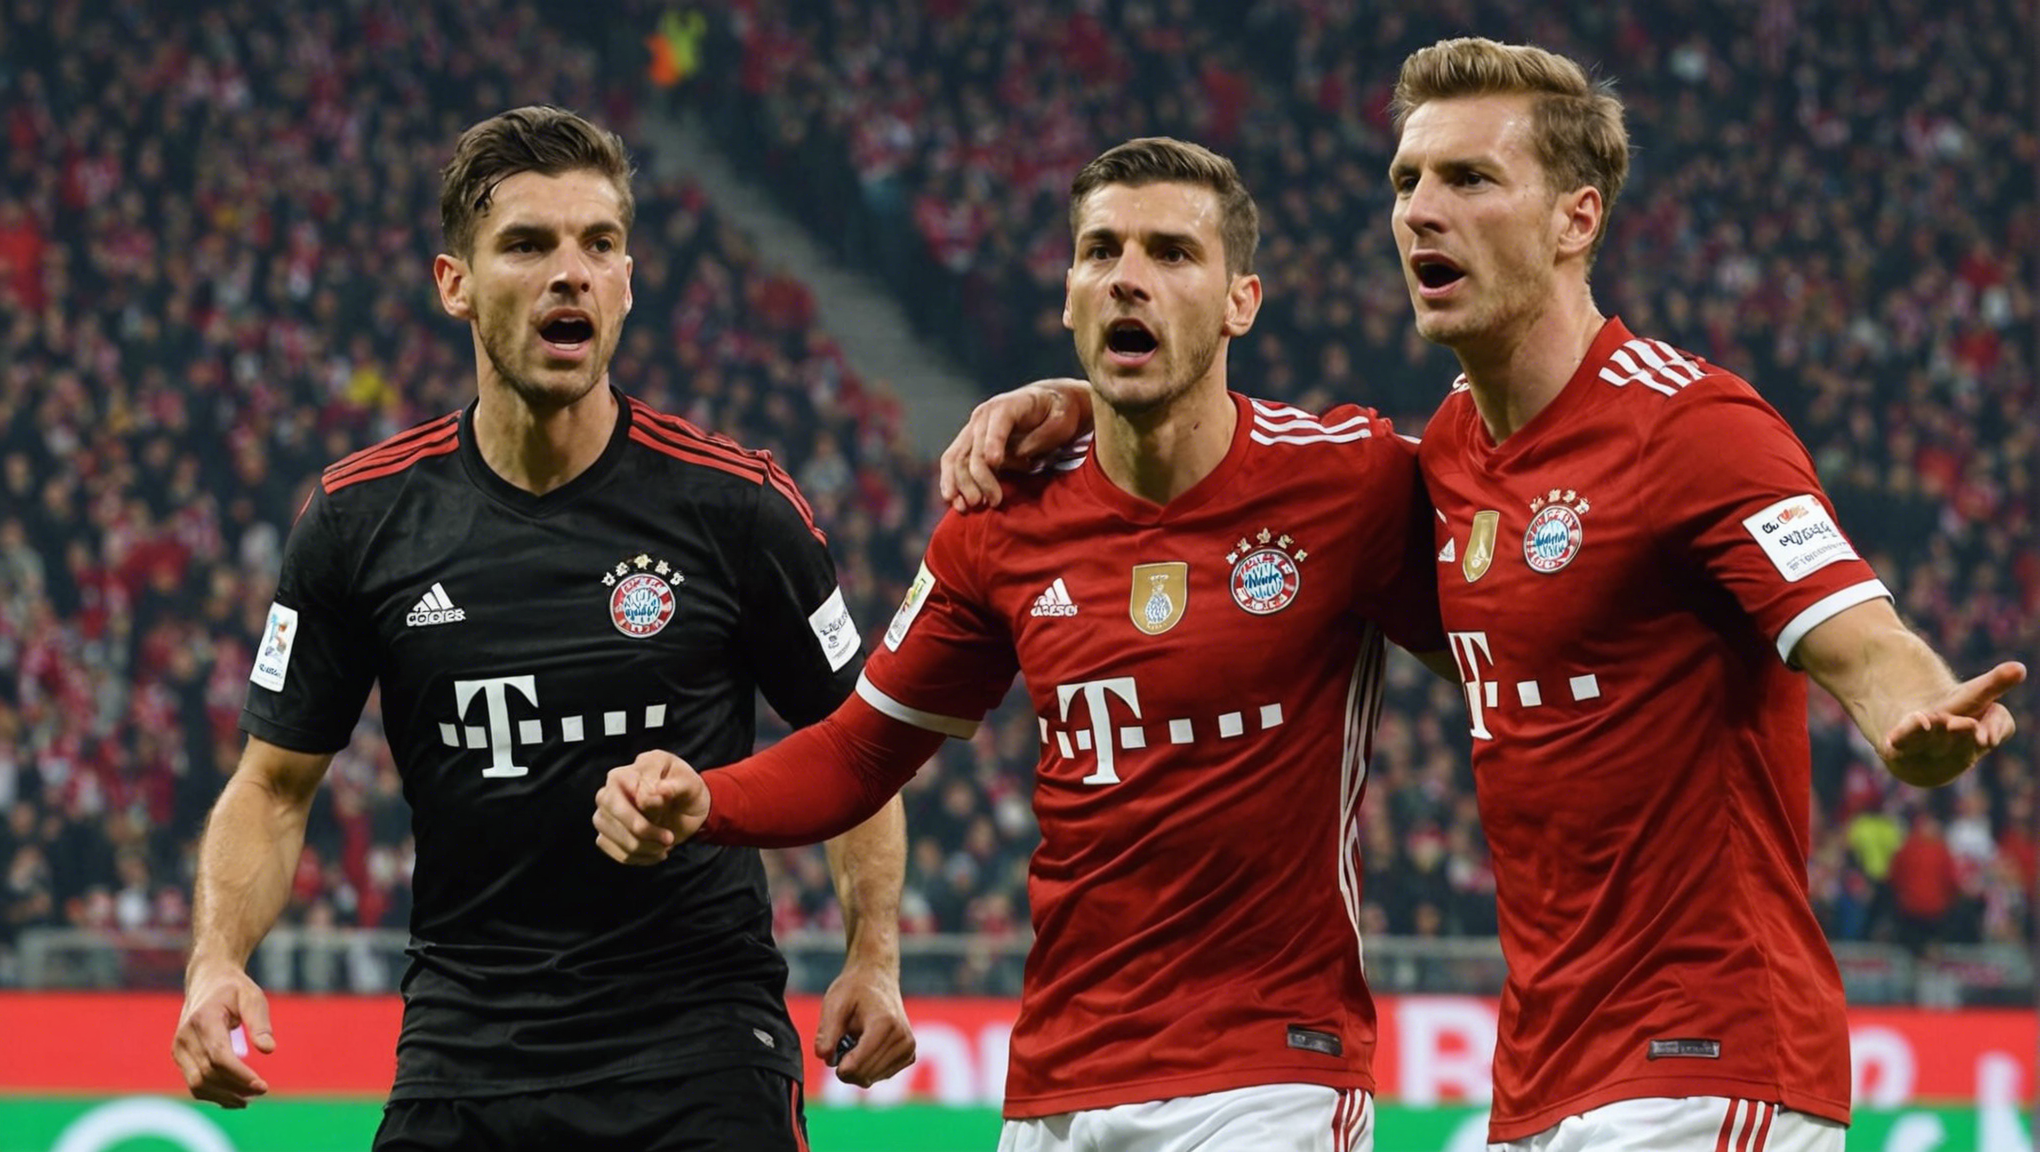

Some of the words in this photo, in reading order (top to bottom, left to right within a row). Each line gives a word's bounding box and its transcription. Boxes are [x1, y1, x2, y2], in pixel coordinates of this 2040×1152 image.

[454, 674, 539, 779] T
[1057, 676, 1143, 785] T
[1448, 631, 1494, 741] T
